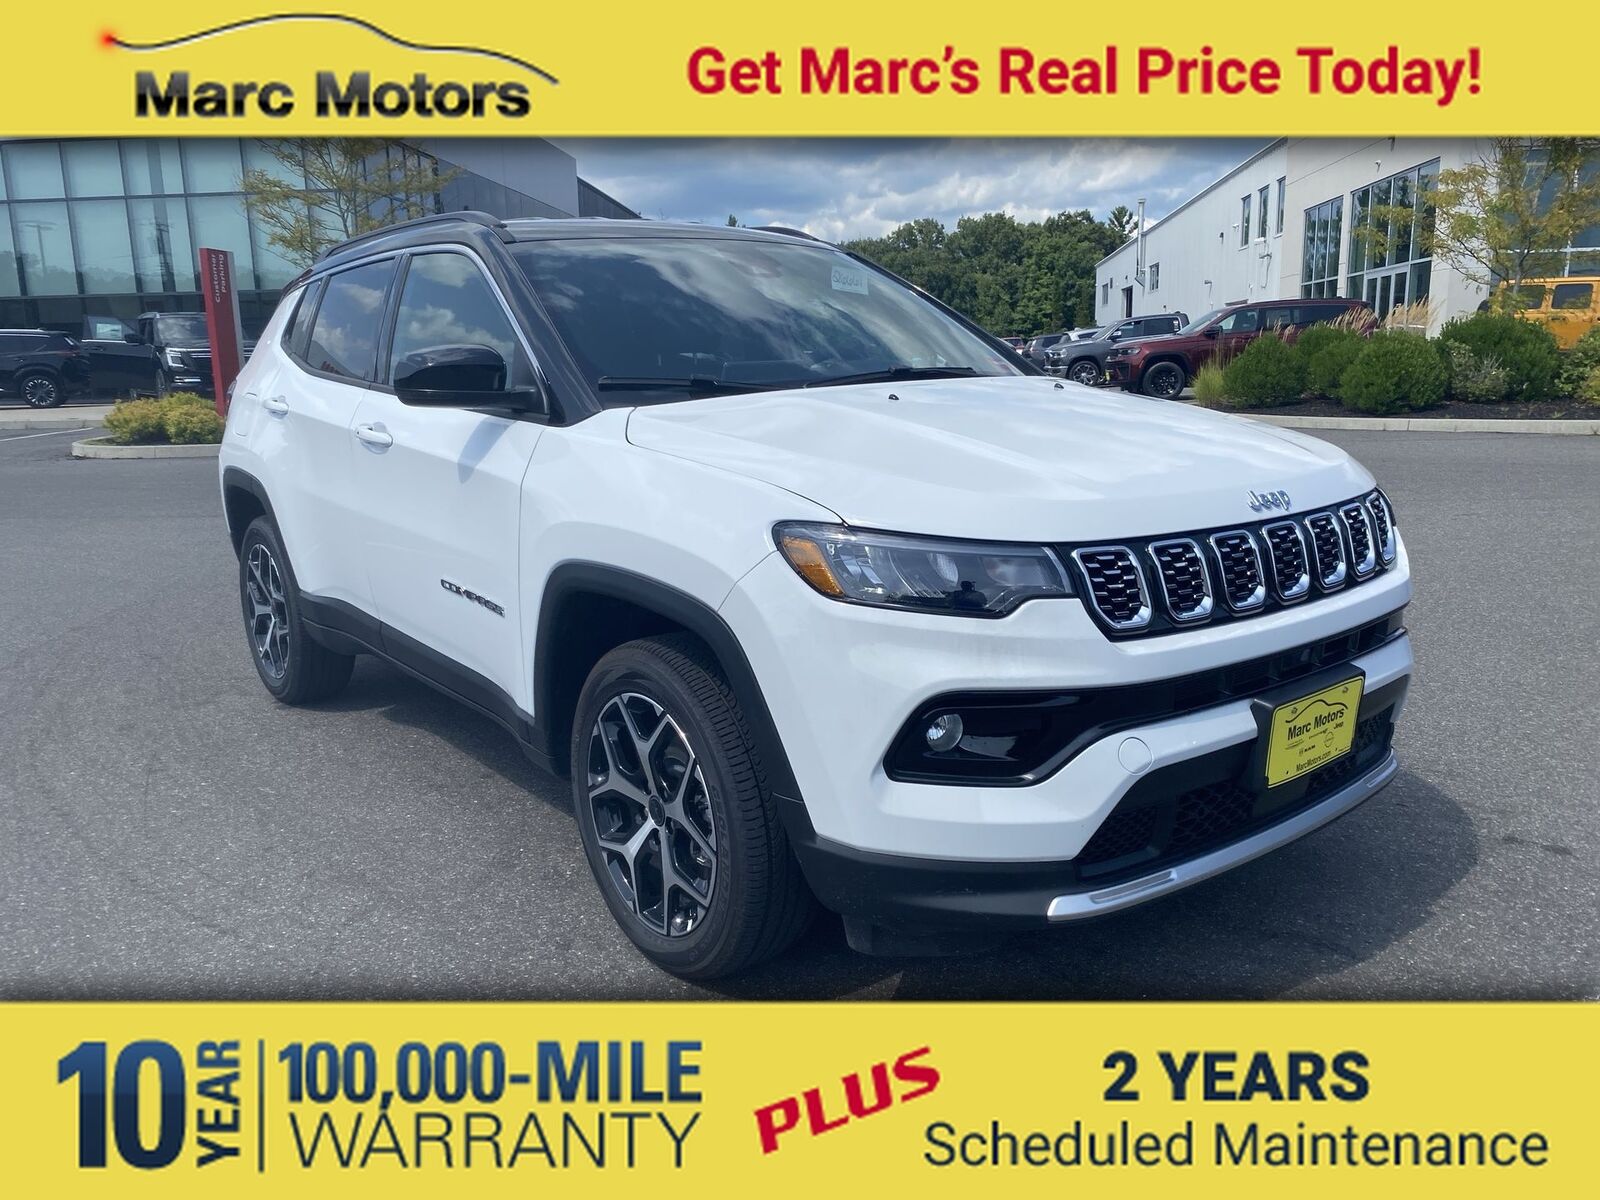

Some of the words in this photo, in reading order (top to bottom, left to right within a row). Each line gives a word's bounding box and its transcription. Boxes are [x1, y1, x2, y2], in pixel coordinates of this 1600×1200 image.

[211, 254, 221, 303] Customer
[219, 254, 227, 293] Parking
[1246, 489, 1292, 513] Jeep
[1287, 721, 1311, 741] Marc
[1313, 708, 1345, 730] Motors
[1296, 752, 1331, 771] MarcMotors.com
